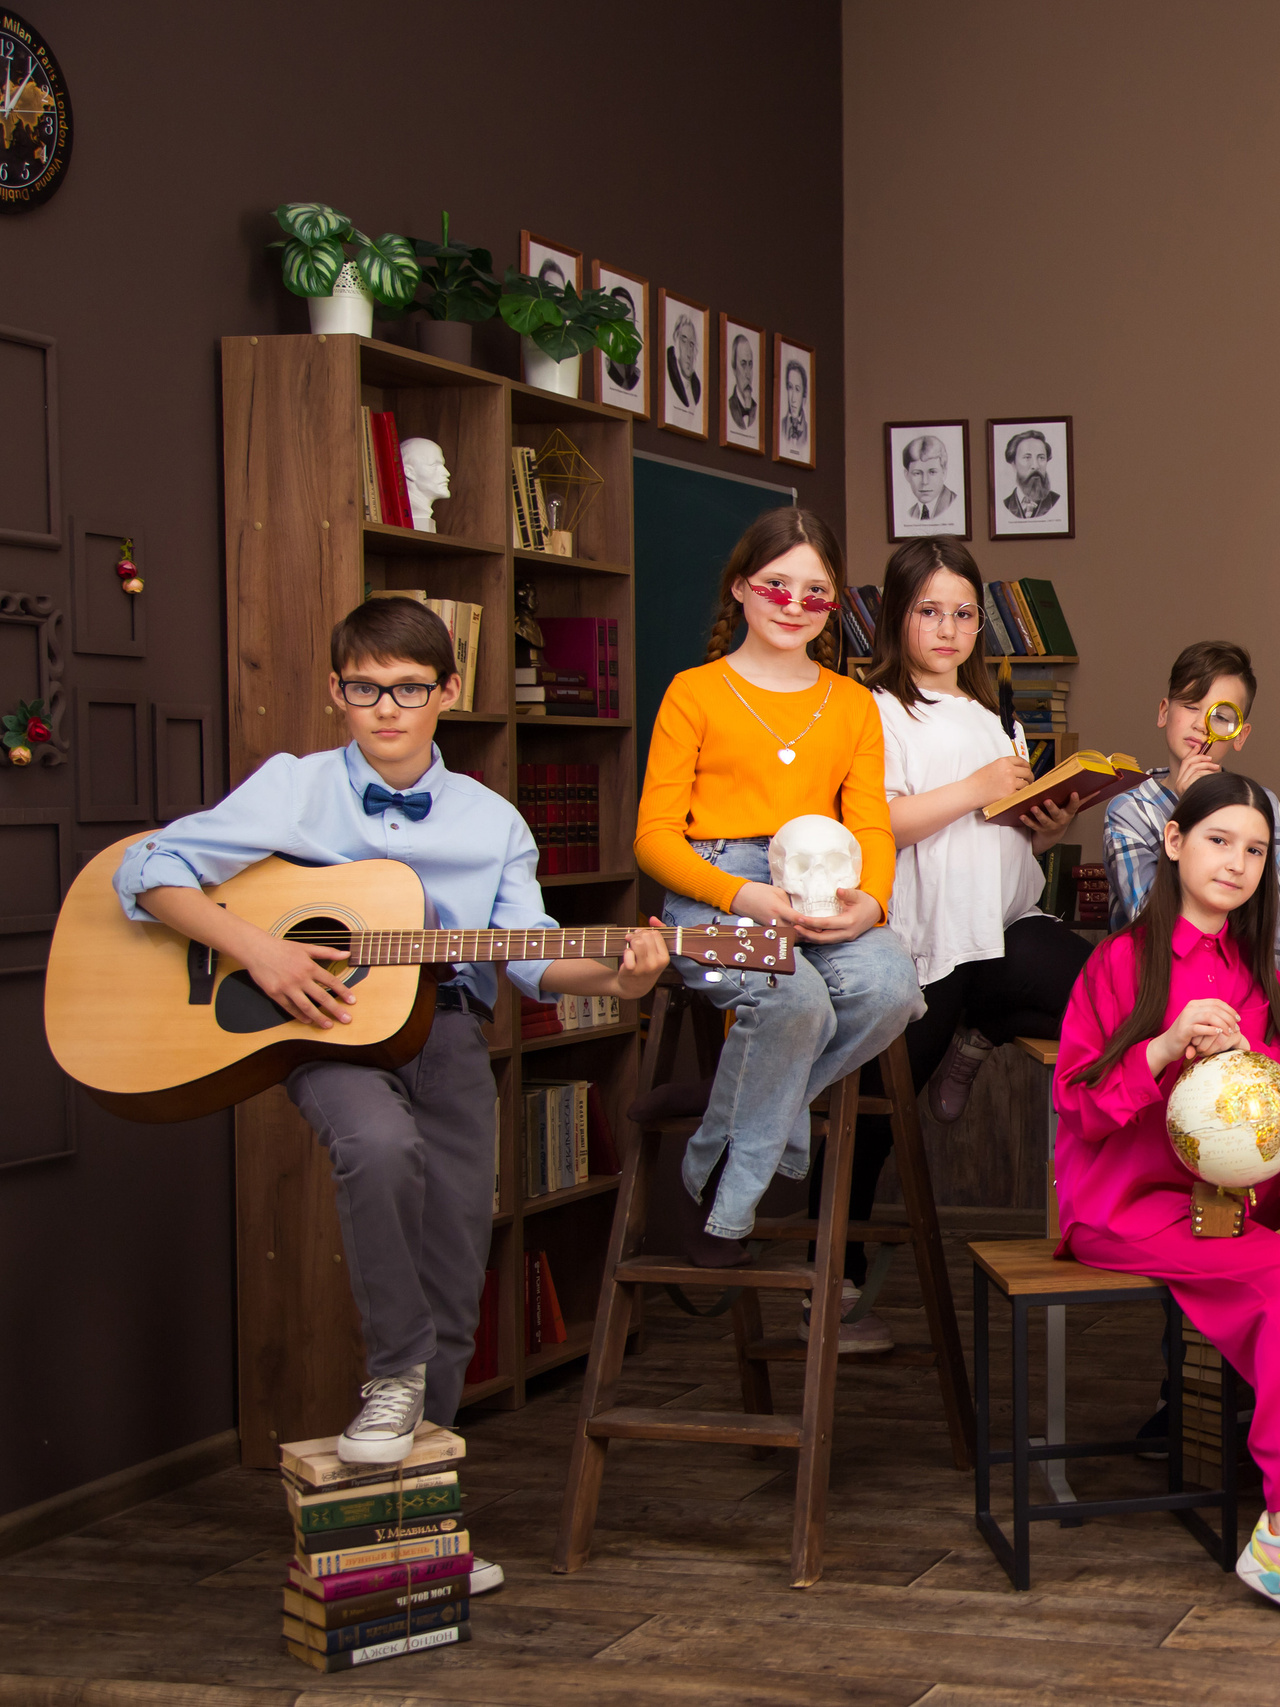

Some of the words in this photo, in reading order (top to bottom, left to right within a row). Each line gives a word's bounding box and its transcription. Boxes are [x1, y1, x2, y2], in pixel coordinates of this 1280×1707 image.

[4, 16, 32, 44] Milan
[37, 46, 57, 81] Paris
[41, 84, 50, 103] 2
[45, 117, 53, 135] 3
[56, 92, 69, 147] London
[0, 162, 8, 181] 6
[21, 162, 30, 180] 5
[35, 158, 63, 191] Vienna
[0, 187, 30, 202] Dubli
[779, 936, 788, 960] YAMAHA
[344, 1553, 387, 1568] ЛУННЫЙ
[390, 1546, 430, 1560] КАМЕНЬ
[396, 1590, 429, 1607] ЧЕРТОВ
[430, 1585, 453, 1599] МОСТ
[360, 1642, 398, 1660] Джек
[402, 1630, 453, 1651] Лондон
